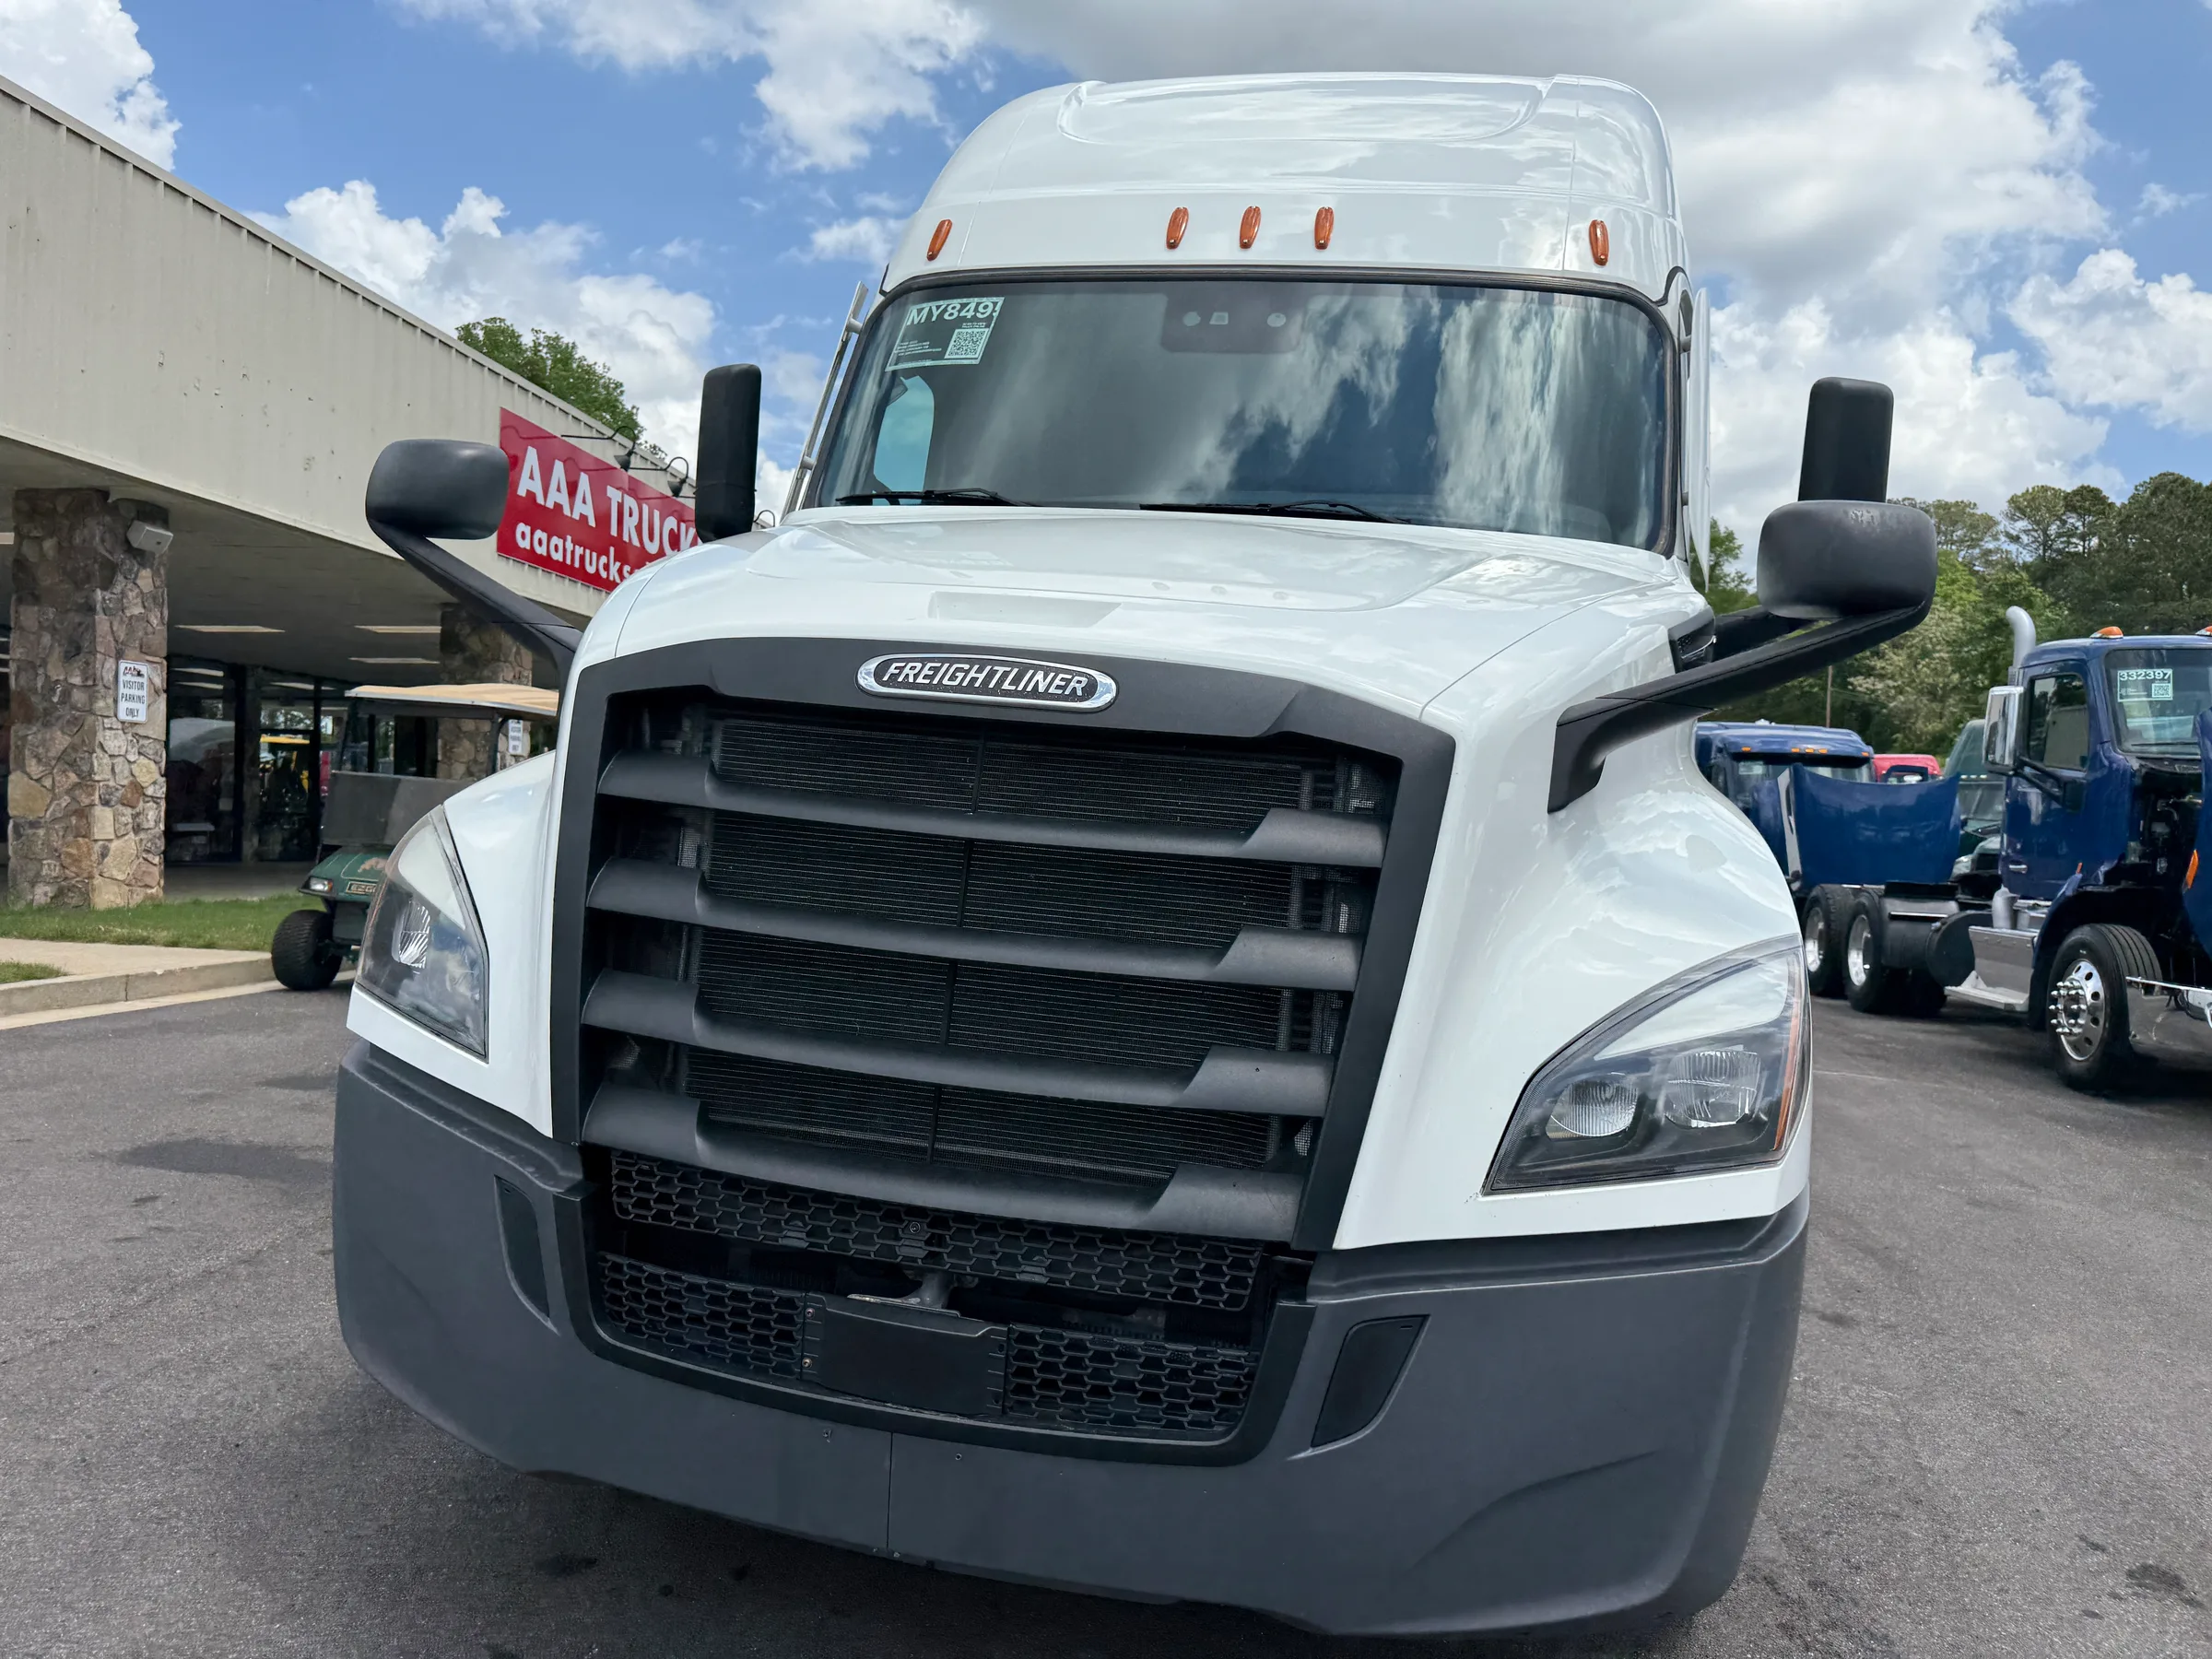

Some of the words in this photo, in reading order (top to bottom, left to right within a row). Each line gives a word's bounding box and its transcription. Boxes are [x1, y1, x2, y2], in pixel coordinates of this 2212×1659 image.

[516, 445, 596, 528] AAA
[606, 485, 700, 556] TRUCK
[515, 522, 648, 583] aaatrucks
[882, 662, 1089, 697] FREIGHTLINER
[2120, 670, 2171, 681] 332397
[122, 679, 145, 691] VISITOR
[121, 692, 146, 704] PARKING
[125, 707, 140, 718] ONLY
